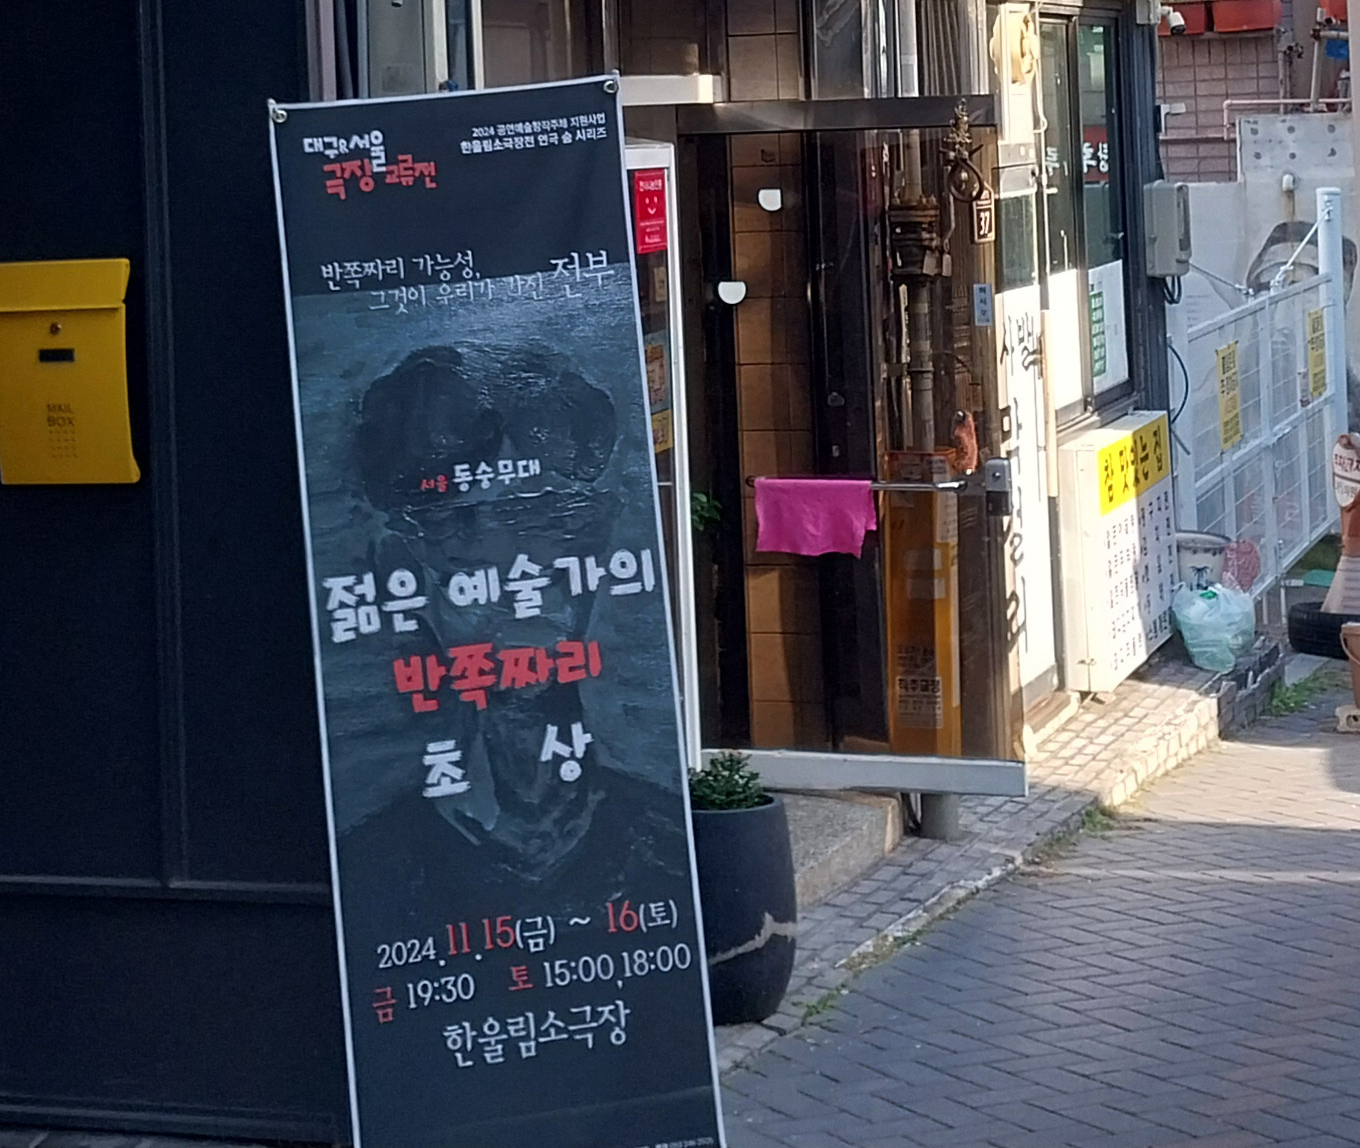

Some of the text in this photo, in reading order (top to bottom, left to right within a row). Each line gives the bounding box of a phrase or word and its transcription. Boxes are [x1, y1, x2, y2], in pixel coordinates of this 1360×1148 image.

[472, 127, 495, 137] 2024
[570, 113, 606, 128] 지원사업
[538, 133, 559, 146] 연극
[576, 127, 608, 141] 시리즈
[980, 211, 990, 235] 37
[321, 250, 481, 291] 반쪽짜리 가능성,
[369, 289, 426, 314] 그것이
[436, 279, 495, 305] 우리가
[550, 250, 614, 298] 전부
[47, 404, 74, 414] MAIL
[47, 416, 75, 427] BOX
[421, 459, 540, 492] 서울 동숭무대
[1119, 435, 1149, 494] 맛있는
[1153, 425, 1163, 472] 집
[322, 549, 654, 644] 젊은 예술가의
[393, 641, 602, 713] 반쪽짜리
[422, 722, 594, 798] 초 상
[606, 899, 678, 933] 16(토)
[372, 988, 397, 1023] 금
[407, 974, 474, 1008] 19:30
[508, 966, 533, 990] 토
[443, 1000, 630, 1068] 한울림소극장
